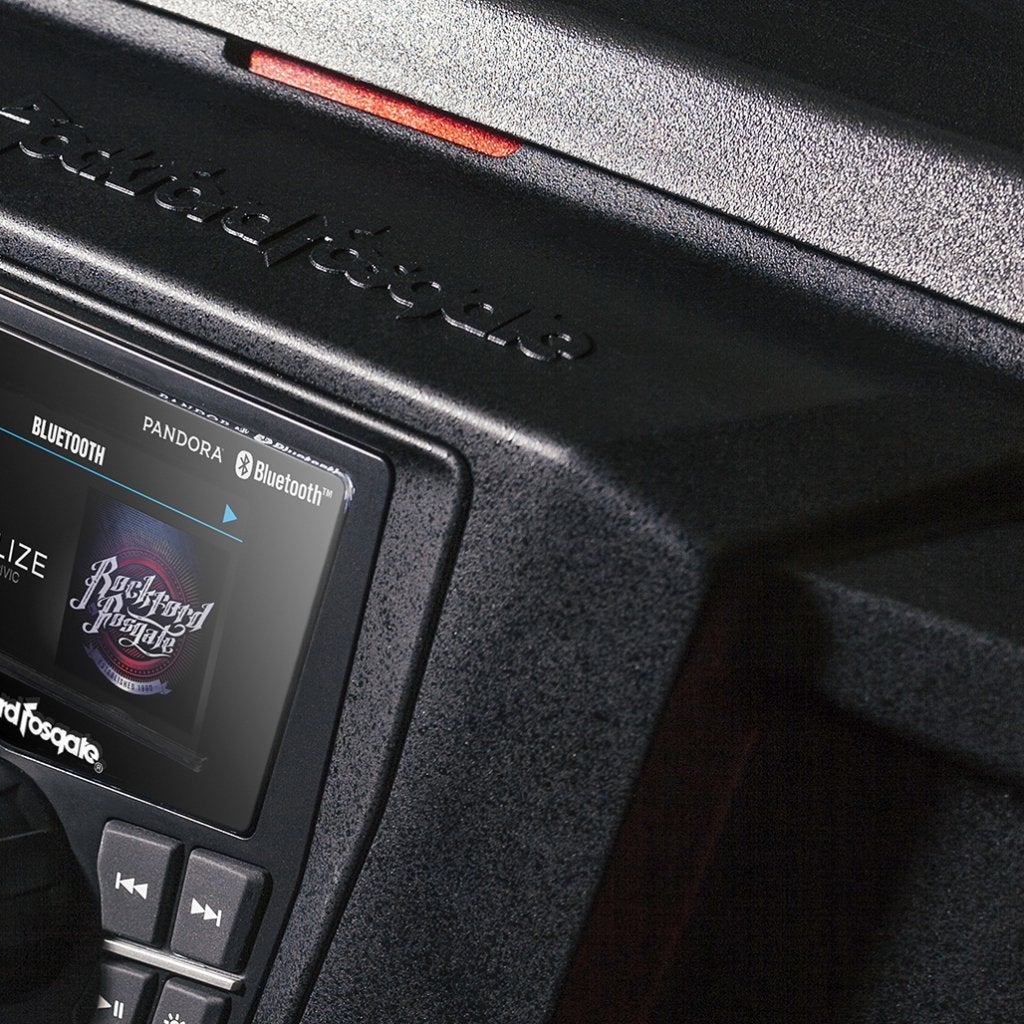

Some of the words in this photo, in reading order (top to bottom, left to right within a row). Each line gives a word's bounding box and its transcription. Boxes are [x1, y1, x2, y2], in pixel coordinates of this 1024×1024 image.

[31, 415, 106, 466] BLUETOOTH
[142, 415, 223, 464] PANDORA
[69, 555, 215, 633] Rockford
